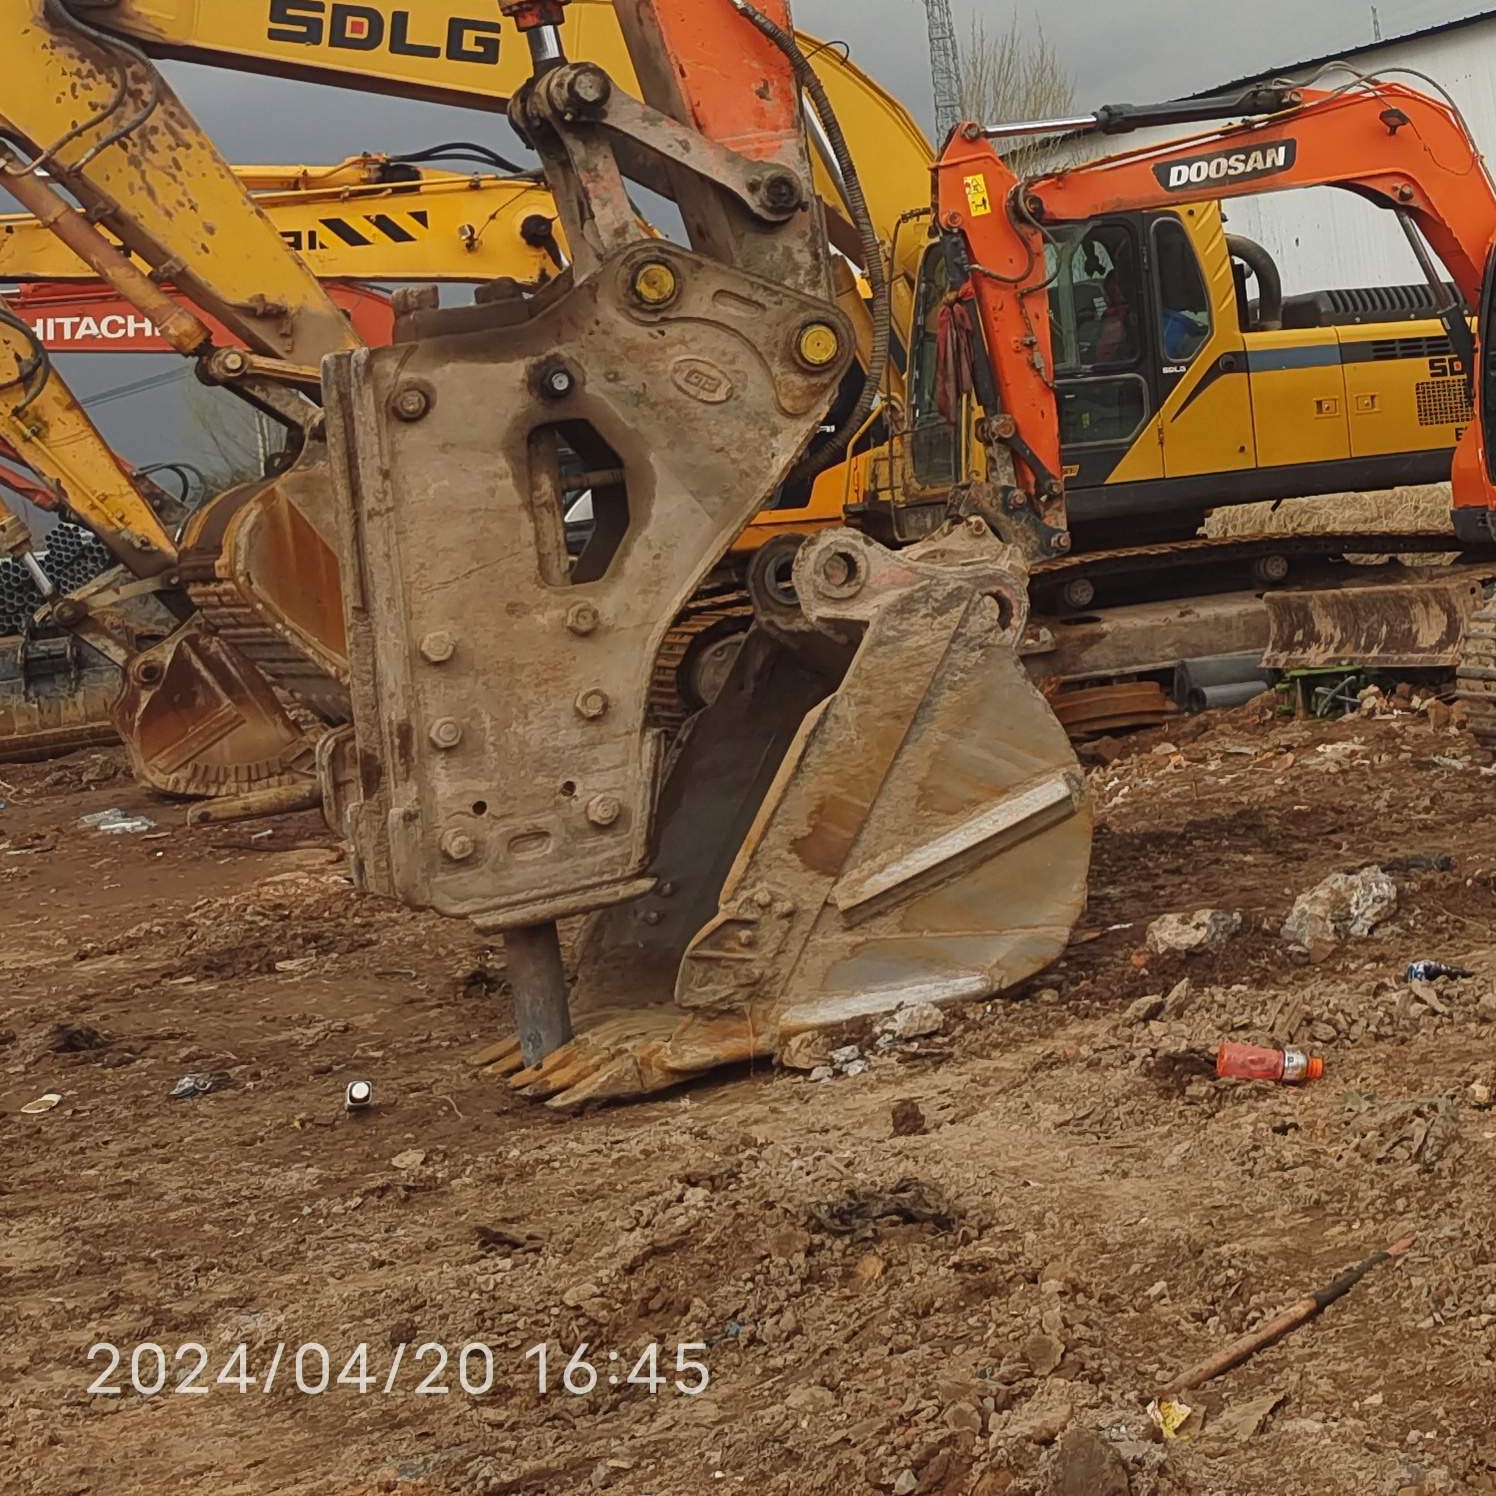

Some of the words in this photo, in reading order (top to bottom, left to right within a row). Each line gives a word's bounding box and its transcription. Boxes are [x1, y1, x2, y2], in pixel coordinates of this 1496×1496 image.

[1168, 145, 1286, 188] DOOSAN
[29, 314, 162, 342] HITACH
[1428, 358, 1466, 378] SD
